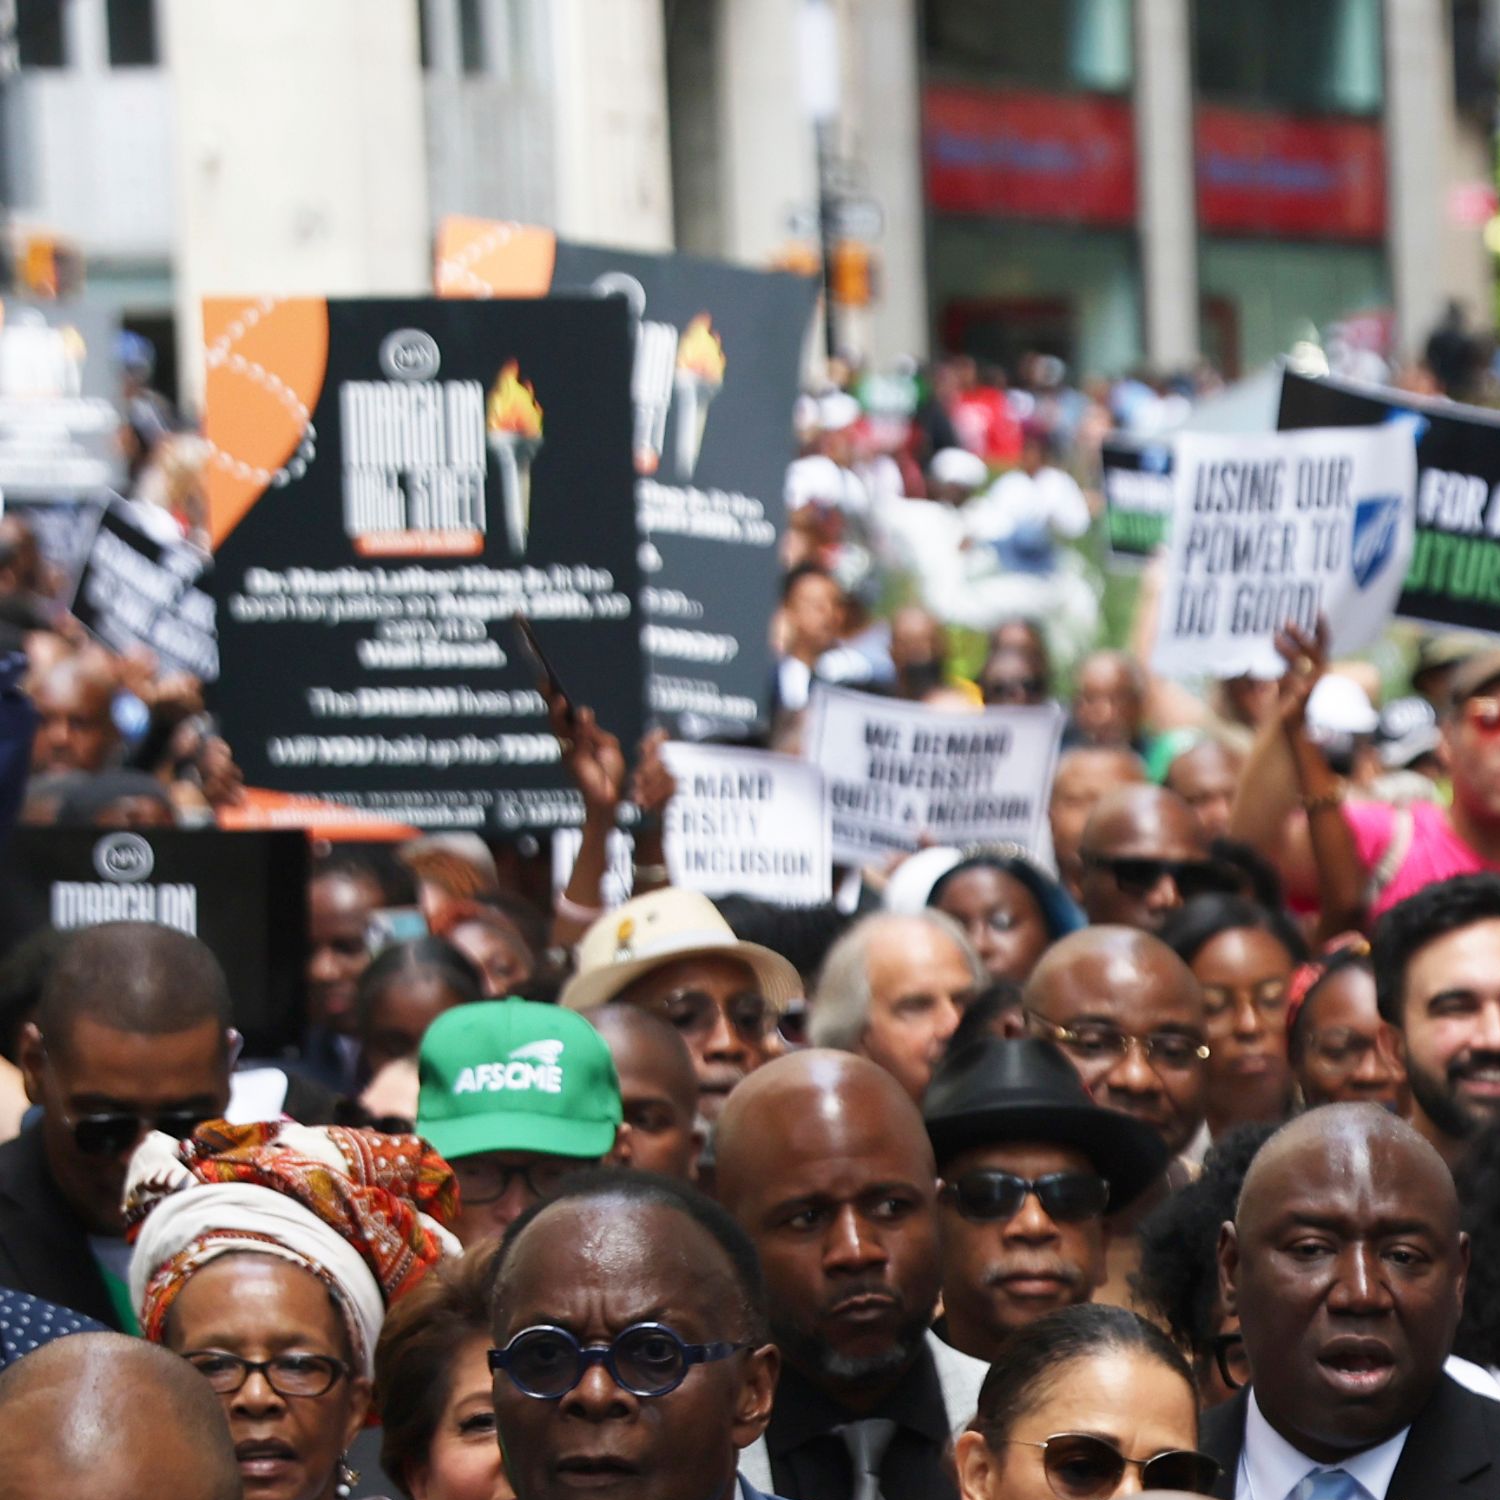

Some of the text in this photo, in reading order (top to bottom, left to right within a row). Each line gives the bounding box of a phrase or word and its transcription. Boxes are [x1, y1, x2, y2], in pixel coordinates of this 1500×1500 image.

[1194, 456, 1285, 513] USING
[1296, 454, 1353, 509] OUR
[1419, 467, 1489, 535] FOR
[1185, 517, 1343, 575] POWER TO
[1175, 582, 1217, 638] DO
[357, 686, 458, 718] DREAM
[316, 735, 377, 766] YOU
[912, 725, 1014, 756] DEMAND
[867, 754, 996, 791] DIVERSITY
[831, 780, 895, 813] QUITY
[926, 799, 1033, 824] INCLUSION
[684, 848, 812, 877] INCLUSION
[454, 1061, 563, 1096] AFSCME
